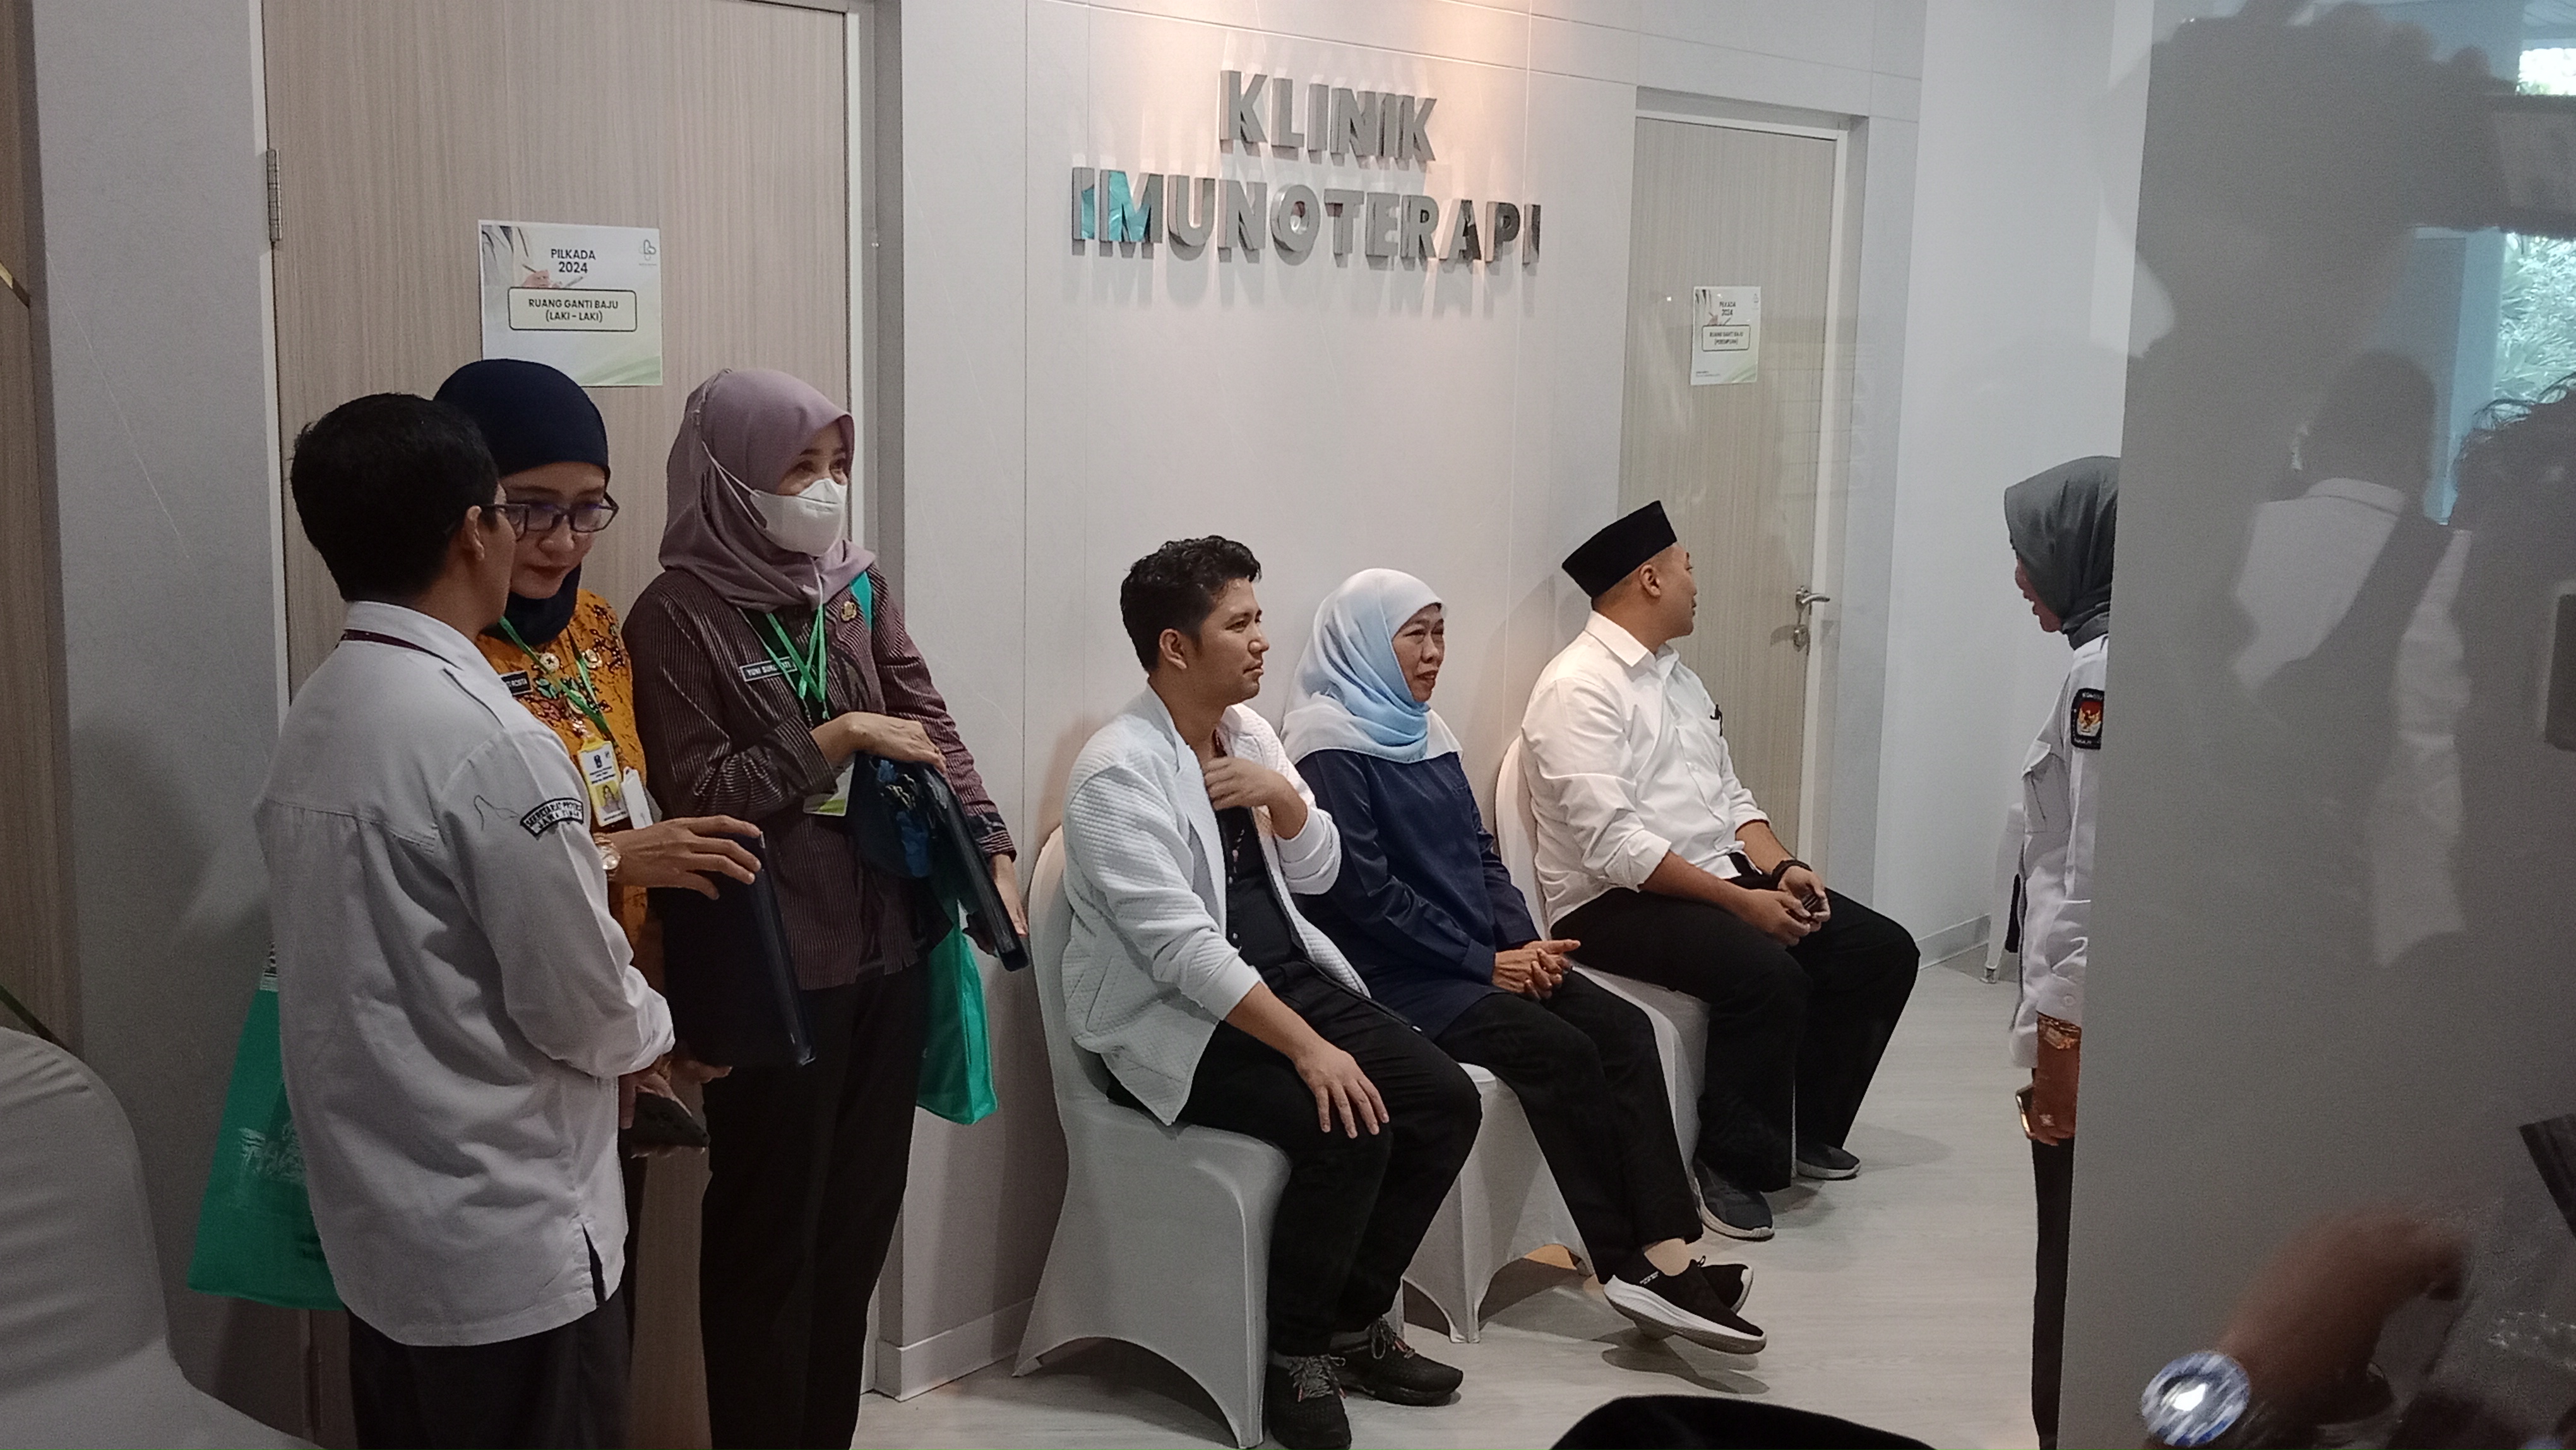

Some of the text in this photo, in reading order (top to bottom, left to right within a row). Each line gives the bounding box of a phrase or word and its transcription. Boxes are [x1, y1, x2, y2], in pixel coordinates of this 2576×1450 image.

[1219, 69, 1438, 162] KLINIK
[1071, 167, 1542, 265] IMUNOTERAPI
[551, 249, 596, 260] PILKADA
[558, 261, 588, 273] 2024
[528, 299, 619, 309] RUANG GANTI BAJU
[546, 309, 570, 322] (LAKI
[578, 309, 603, 323] LAKI)
